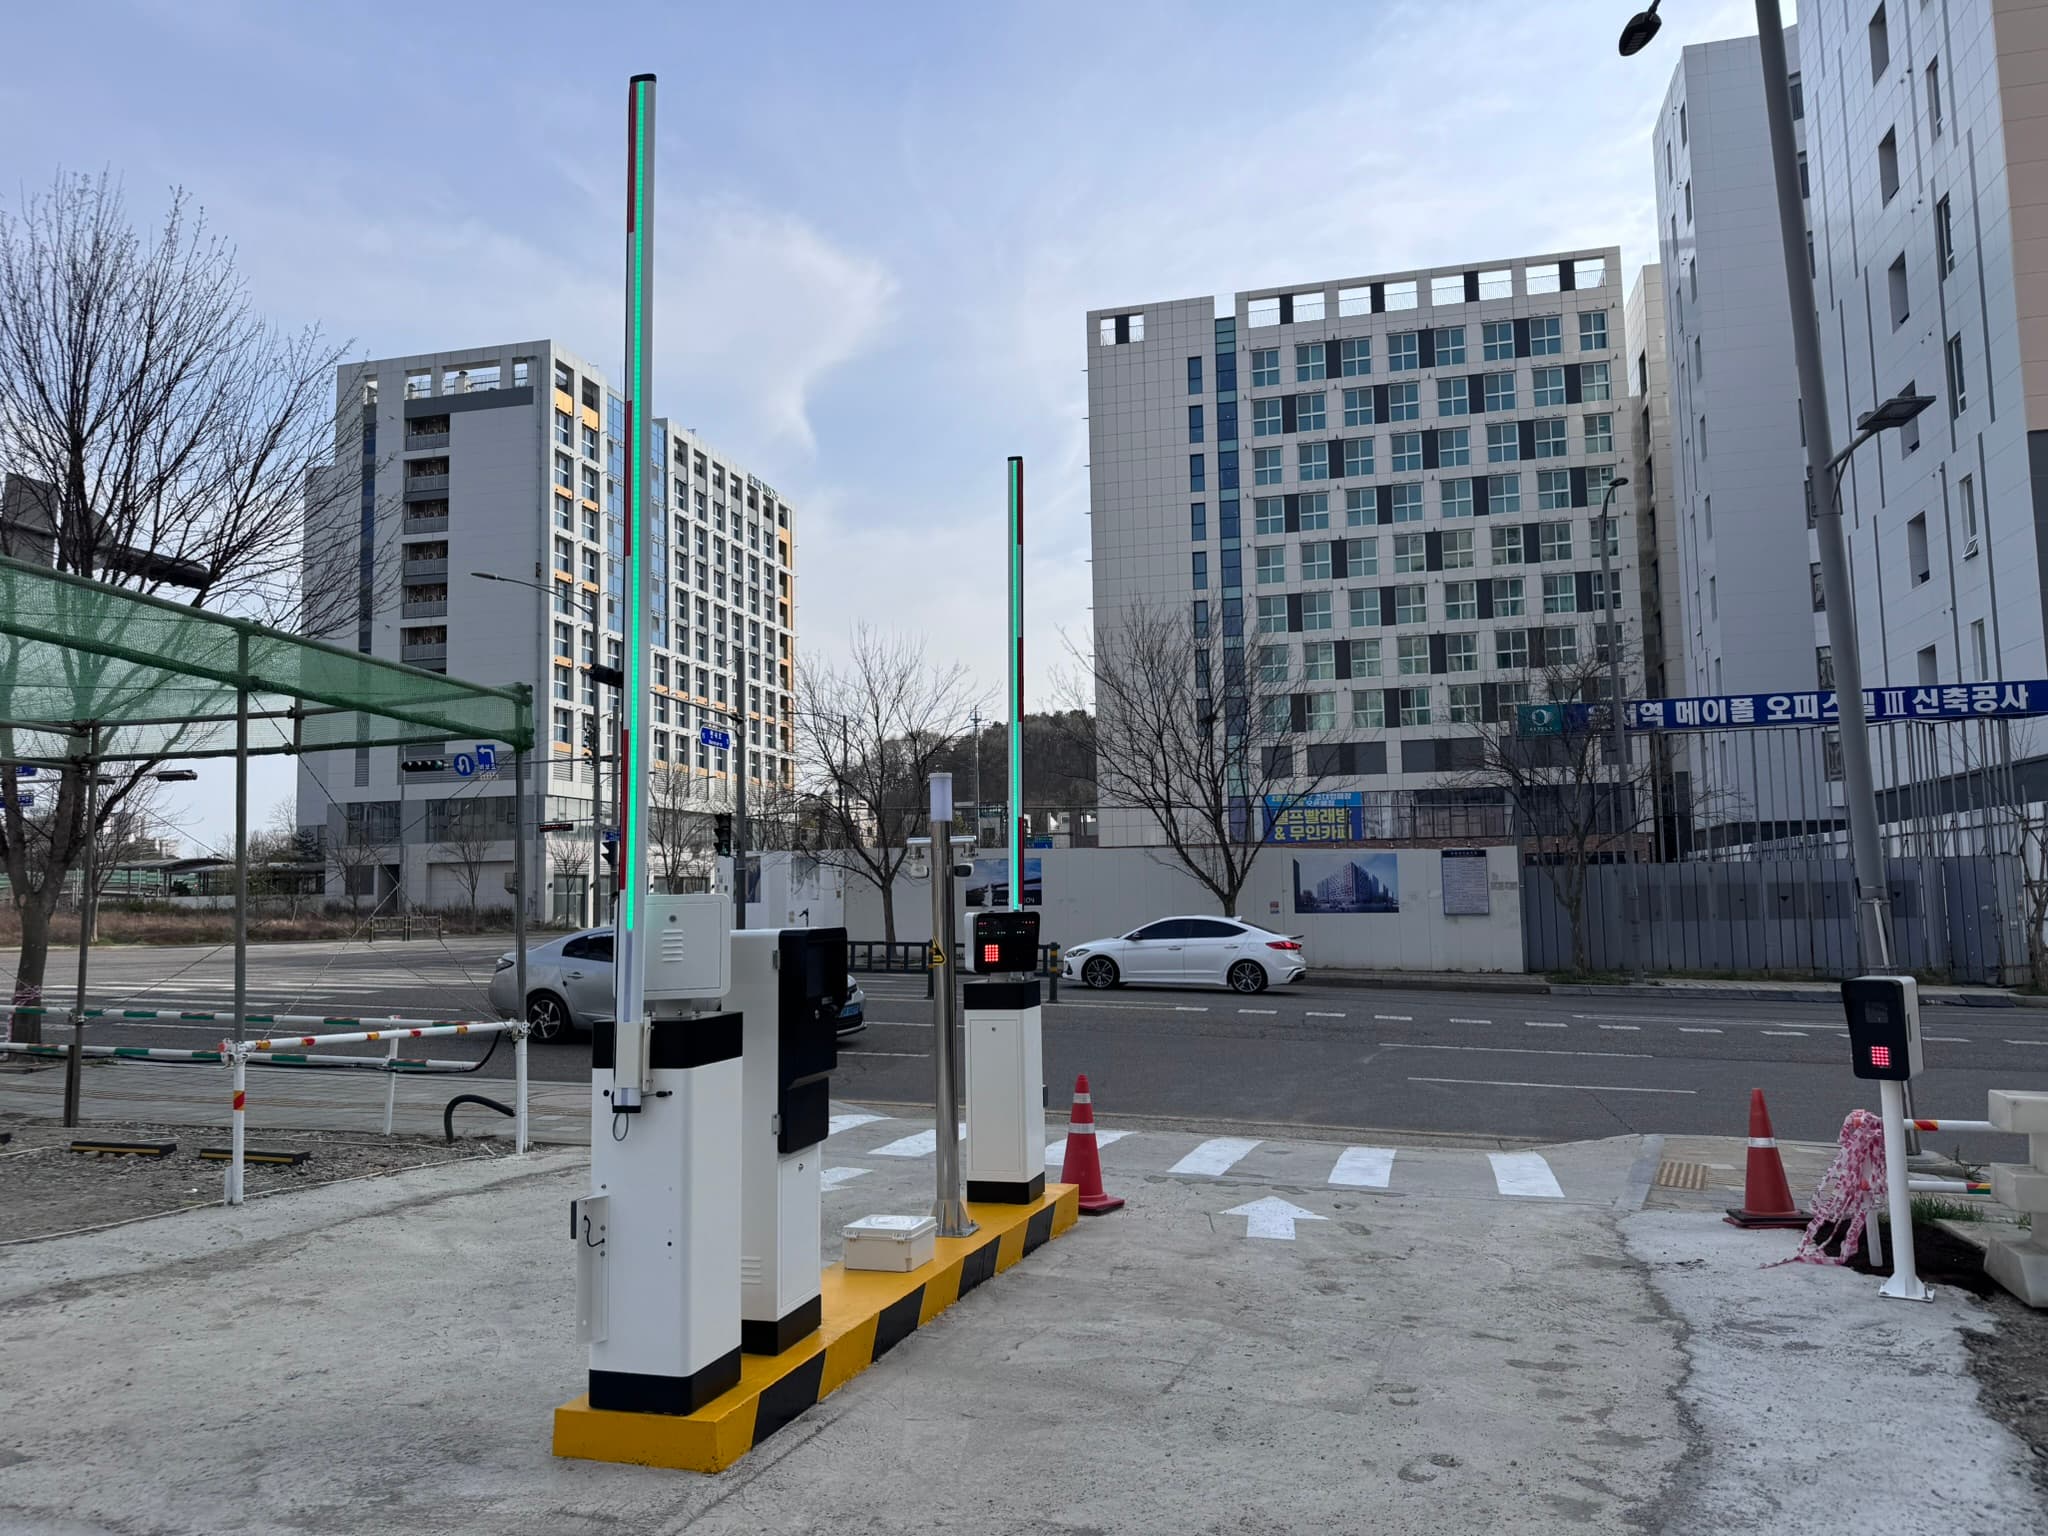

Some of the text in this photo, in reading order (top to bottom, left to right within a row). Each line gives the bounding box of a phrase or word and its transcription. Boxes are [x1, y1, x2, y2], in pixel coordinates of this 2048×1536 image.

[1675, 698, 1755, 727] 메이폴
[1912, 683, 2029, 713] 신축공사
[1275, 826, 1286, 840] &
